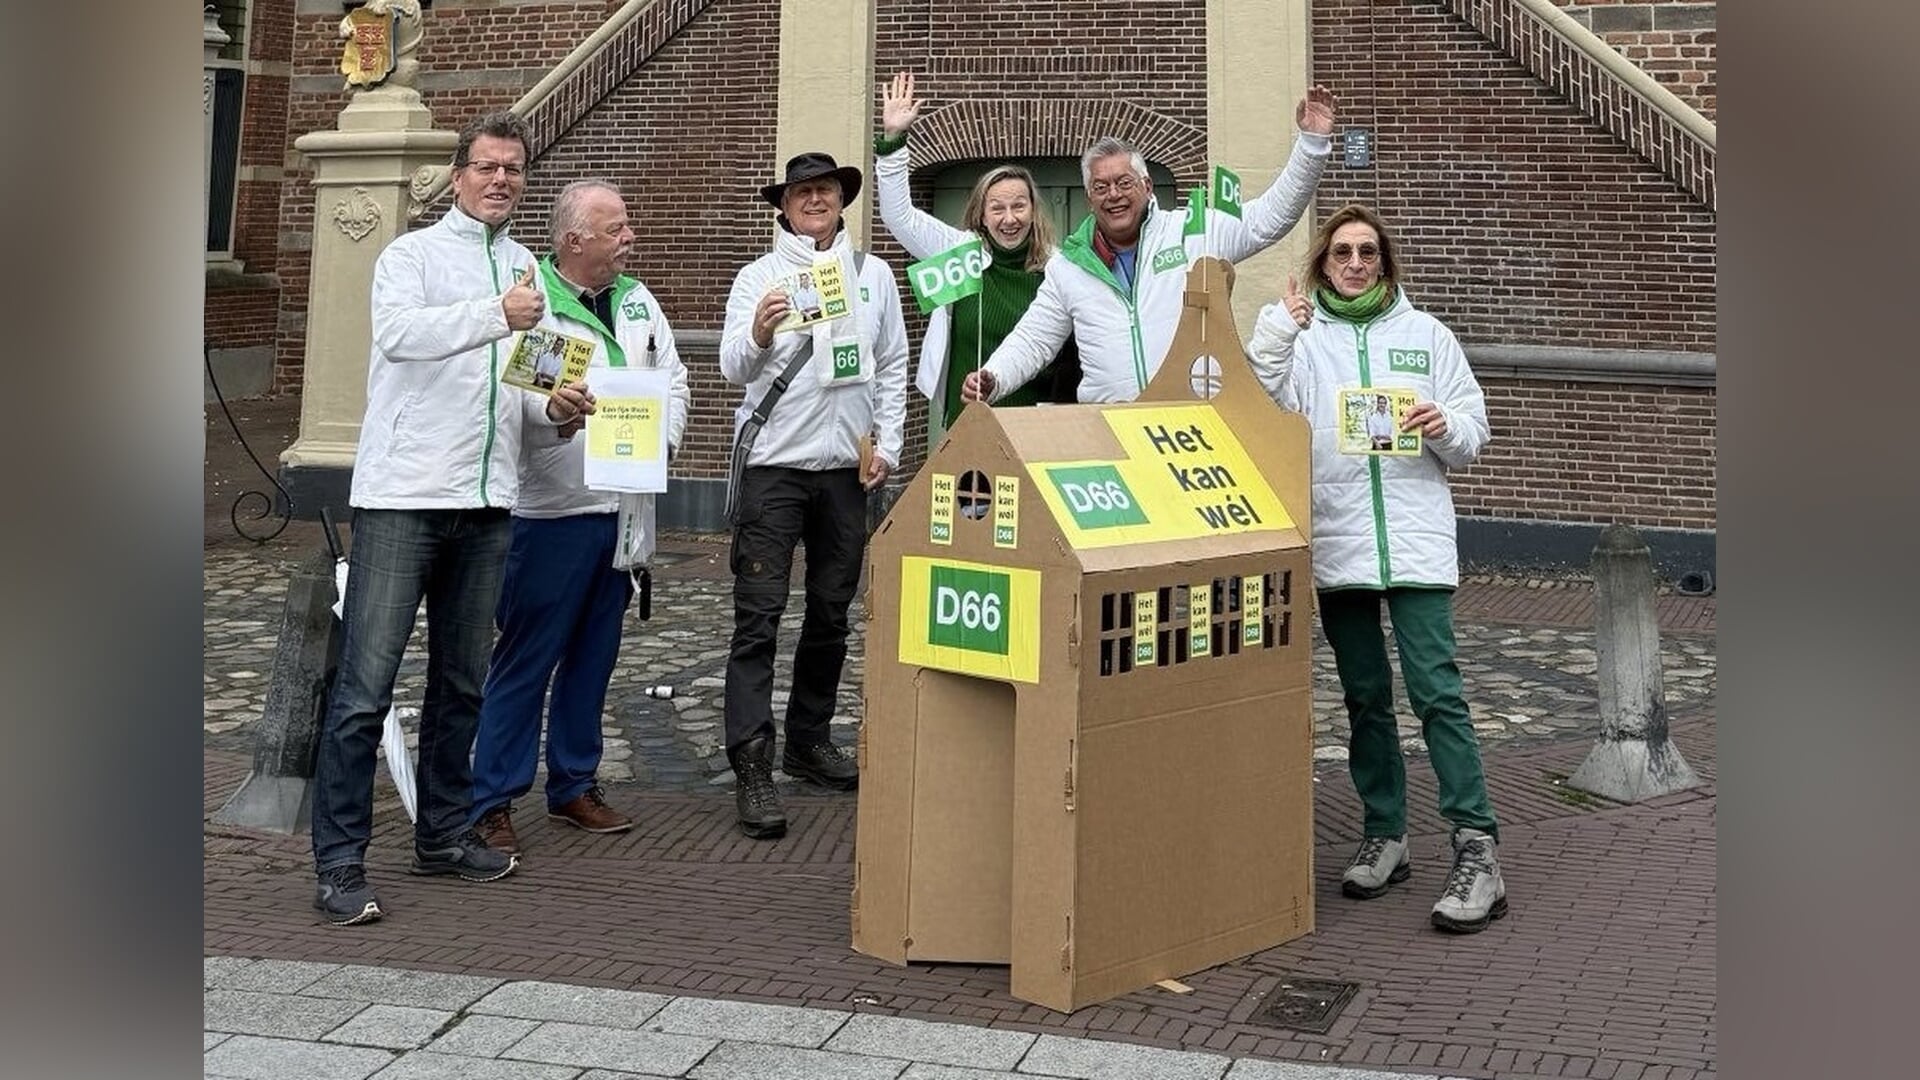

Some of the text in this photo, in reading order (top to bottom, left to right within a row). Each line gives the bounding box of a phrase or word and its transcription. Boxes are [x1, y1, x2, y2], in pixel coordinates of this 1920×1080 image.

[1155, 249, 1184, 268] D66
[819, 266, 837, 277] Het
[917, 249, 982, 298] D66
[822, 278, 840, 287] kan
[827, 301, 845, 312] D66
[574, 344, 591, 355] Het
[570, 354, 586, 366] kan
[1393, 352, 1427, 368] D66
[1398, 396, 1415, 406] Het
[1143, 424, 1214, 455] Het
[1399, 438, 1416, 448] D66
[1167, 462, 1236, 492] kan
[935, 480, 951, 490] Het
[998, 481, 1015, 492] Het
[935, 493, 950, 503] kan
[998, 495, 1014, 506] kan
[1063, 480, 1130, 513] D66
[1195, 494, 1262, 529] wél
[934, 526, 949, 537] D66
[998, 529, 1013, 540] D66
[1246, 582, 1259, 592] Het
[1193, 592, 1206, 602] Het
[1246, 596, 1259, 605] kan
[936, 586, 1000, 632] D66
[1138, 599, 1152, 609] Het
[1193, 606, 1206, 616] kan
[1138, 613, 1152, 623] kan
[1247, 628, 1259, 638] D66
[1194, 638, 1206, 649] D66
[1138, 646, 1152, 657] D66
